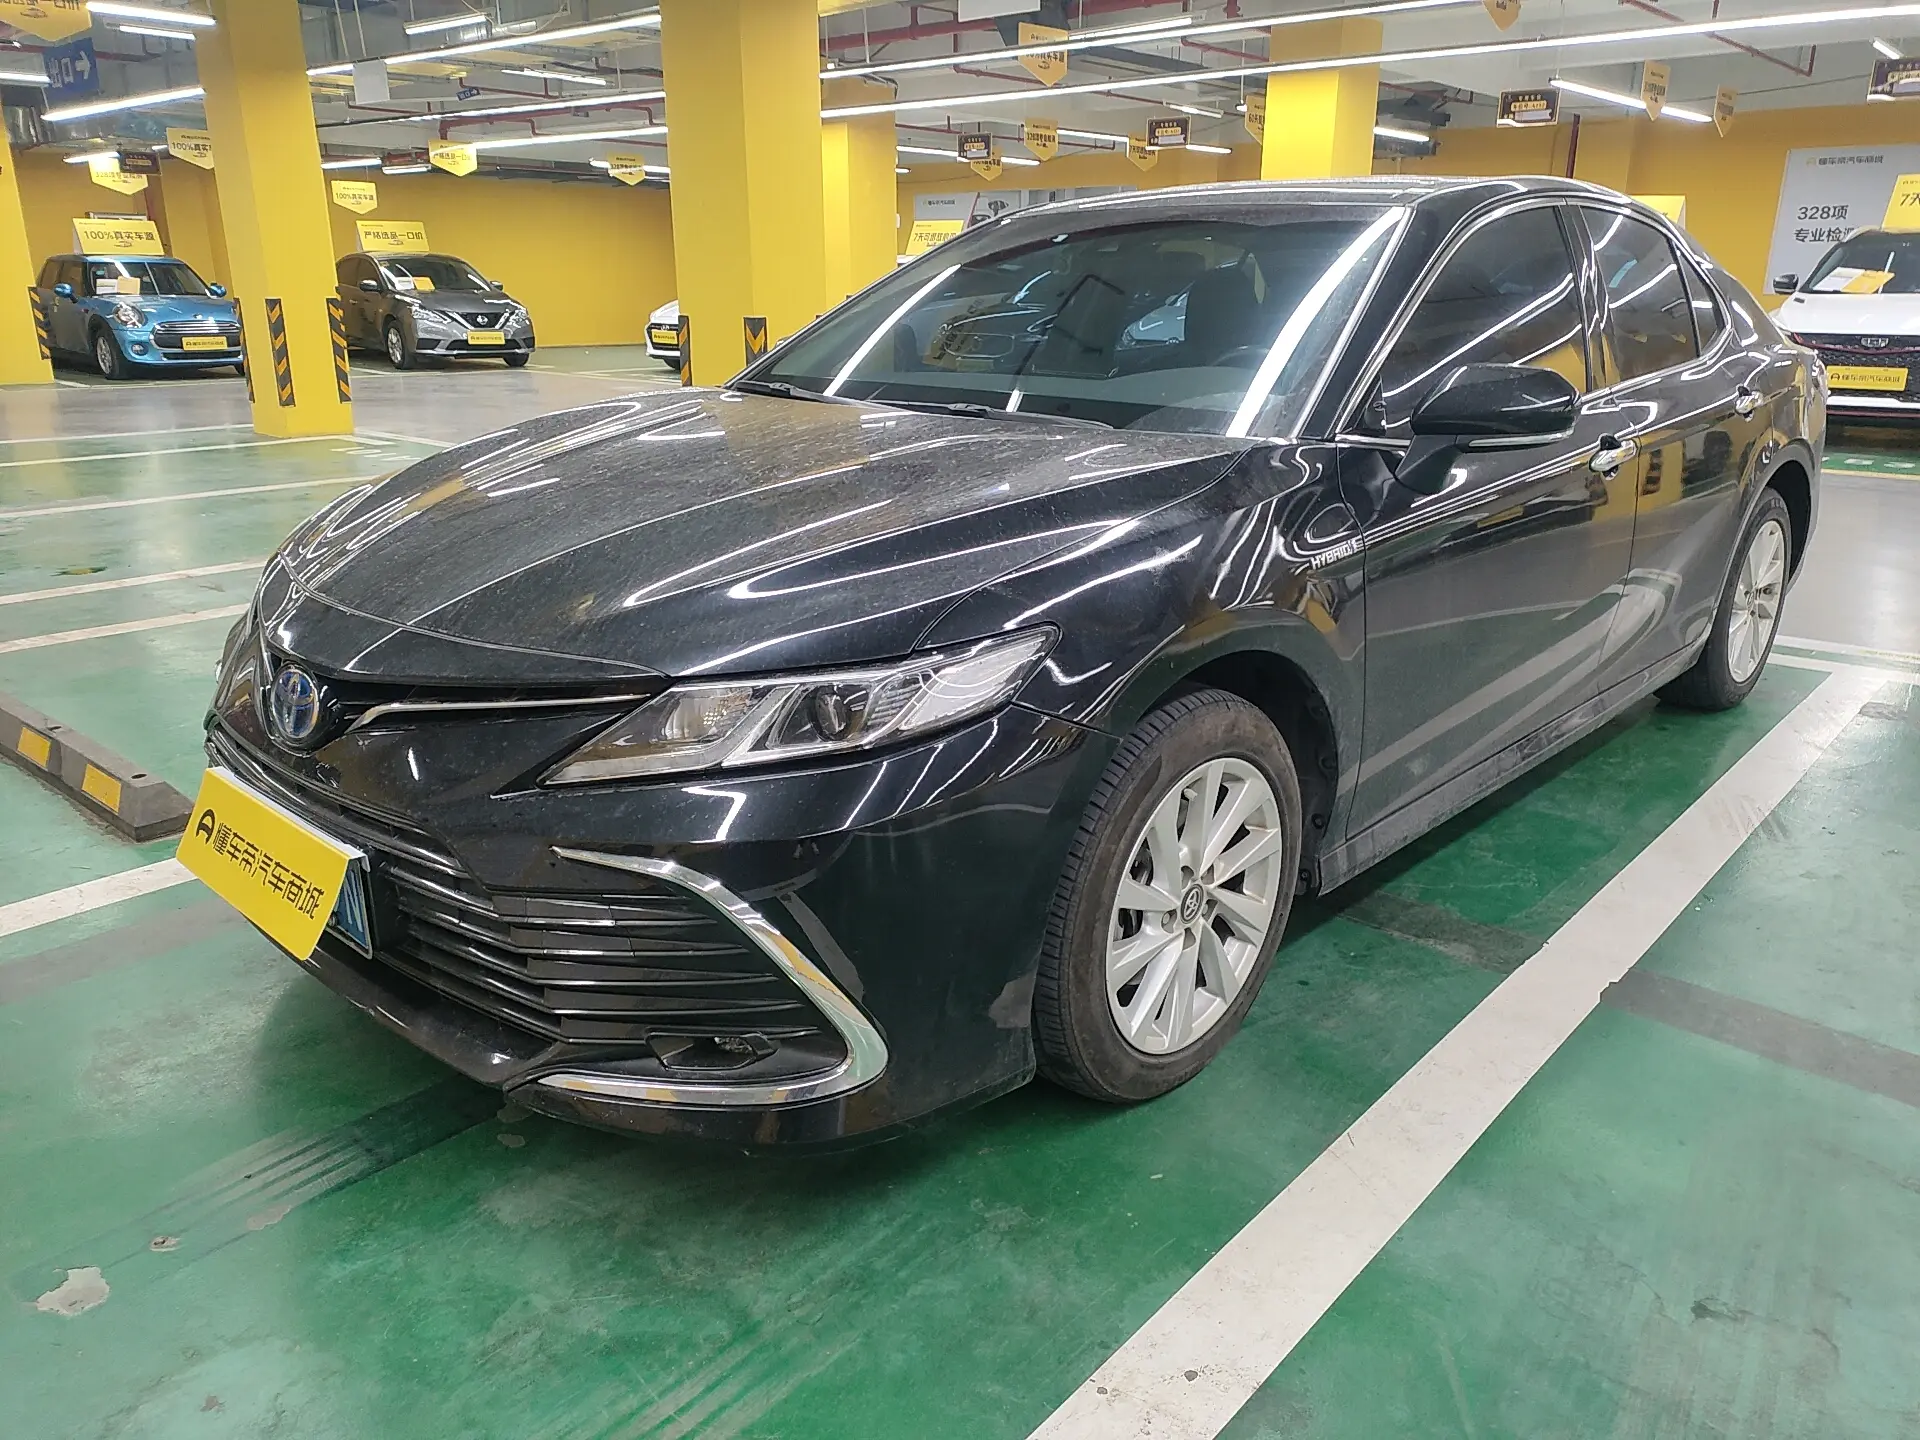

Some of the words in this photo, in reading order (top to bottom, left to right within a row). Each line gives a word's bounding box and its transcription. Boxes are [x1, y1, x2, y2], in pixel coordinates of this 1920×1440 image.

[50, 56, 74, 89] 出口
[1797, 204, 1849, 220] 328项
[84, 230, 155, 241] 100%真实车源
[1310, 544, 1352, 570] HYBRID
[213, 822, 325, 919] 懂车帝汽车商城
